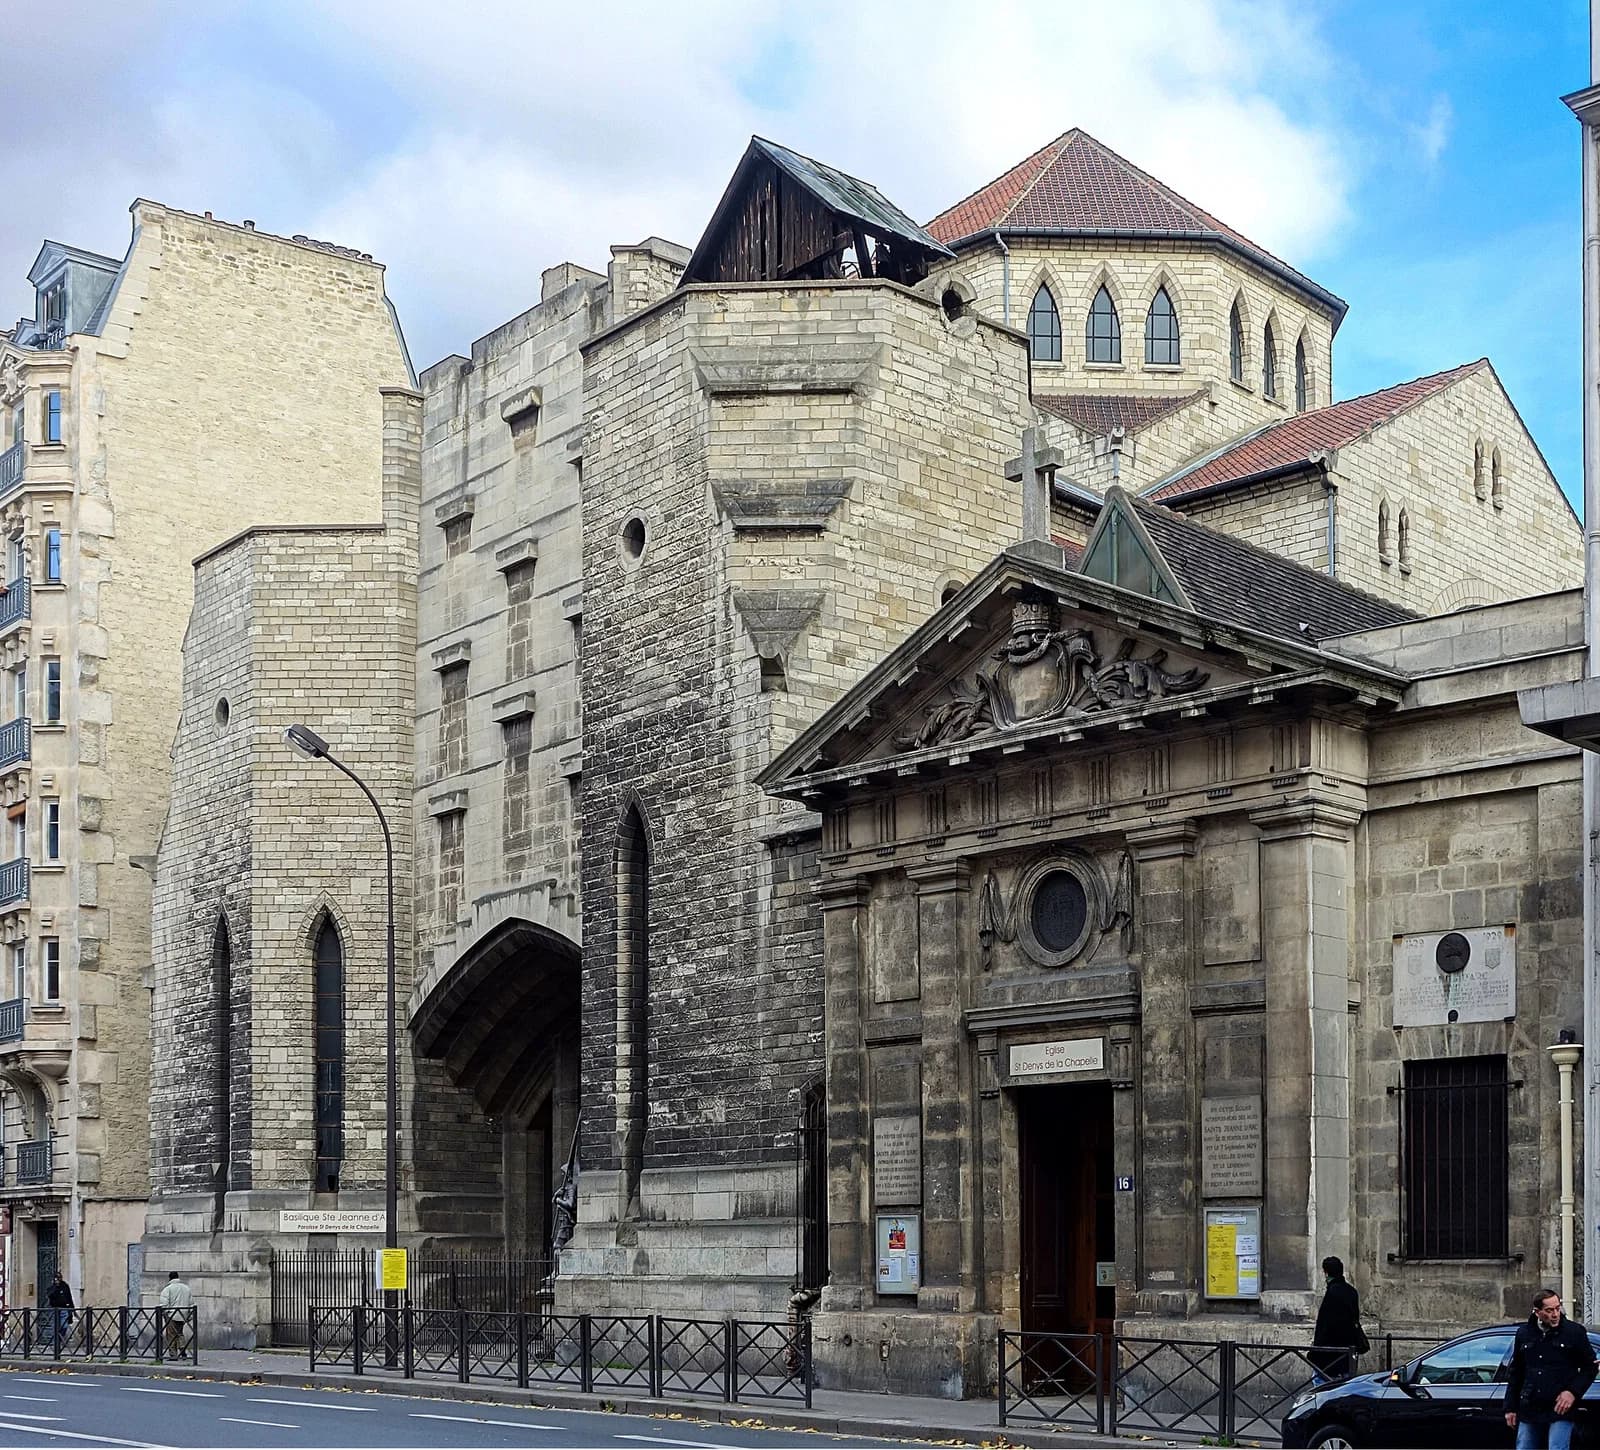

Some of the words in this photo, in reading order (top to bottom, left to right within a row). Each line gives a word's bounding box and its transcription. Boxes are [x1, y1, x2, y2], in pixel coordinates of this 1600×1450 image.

[1045, 1046, 1065, 1056] Eglise
[1023, 1061, 1043, 1071] Denys
[1045, 1060, 1055, 1069] de
[1056, 1059, 1063, 1068] la
[1065, 1057, 1098, 1067] Chapelle
[1118, 1177, 1129, 1190] 16
[283, 1213, 320, 1222] Basilique
[322, 1212, 336, 1221] Ste
[338, 1212, 370, 1221] Jeanne
[371, 1212, 386, 1221] d'A
